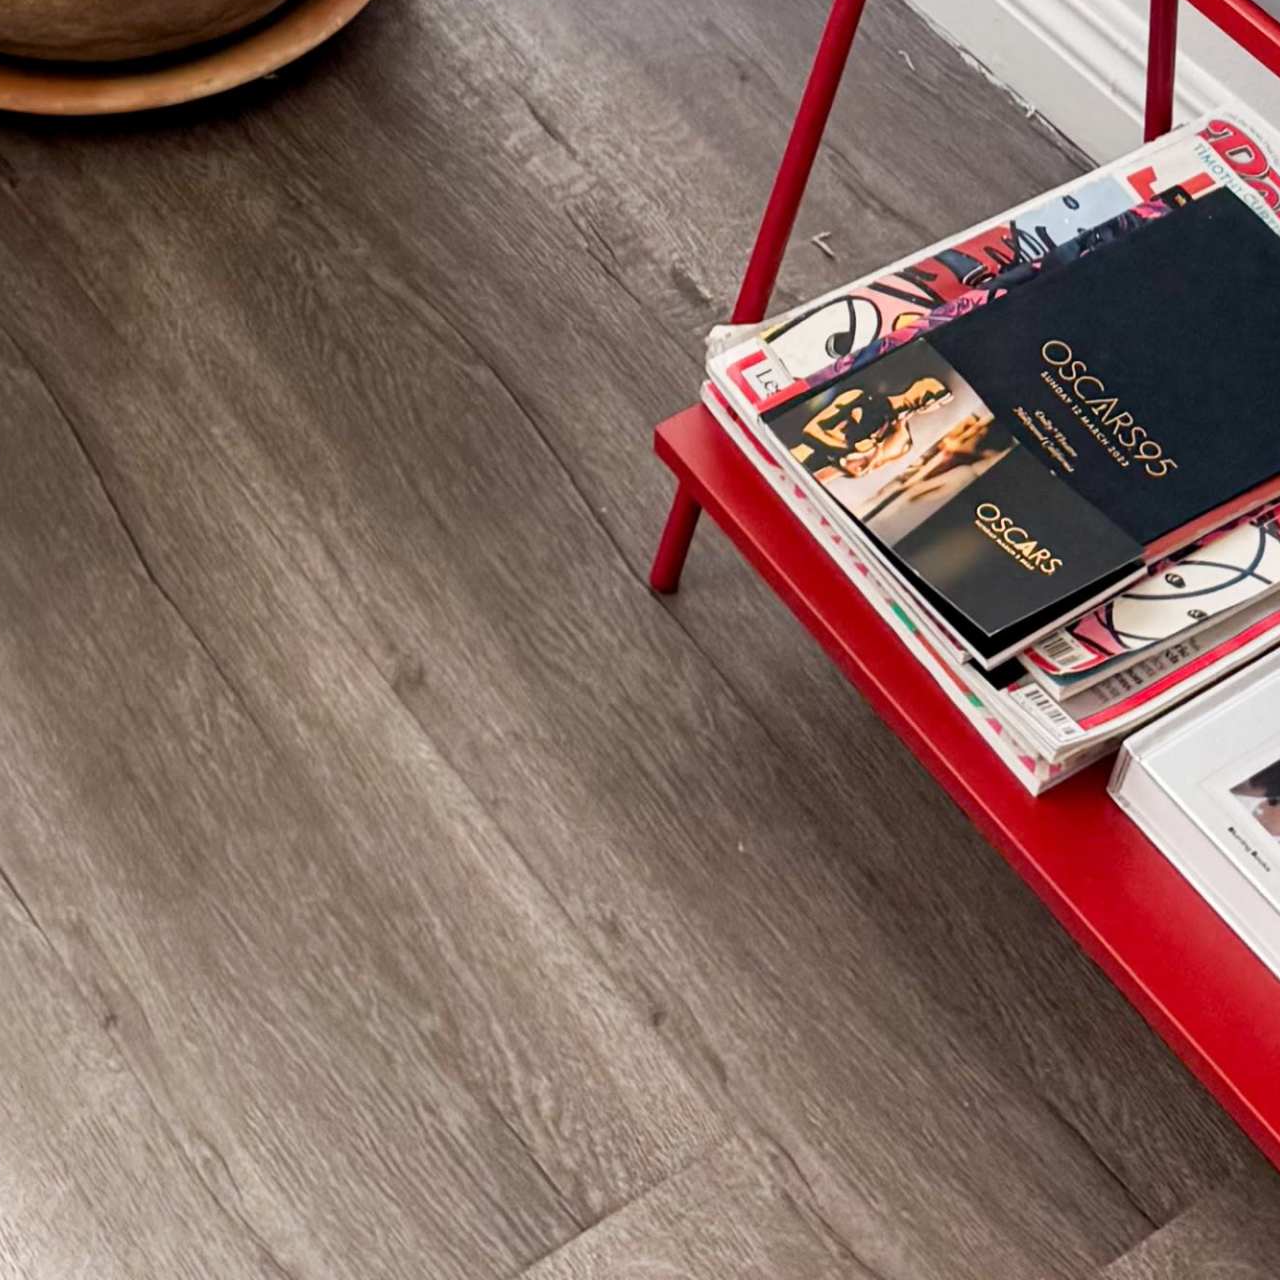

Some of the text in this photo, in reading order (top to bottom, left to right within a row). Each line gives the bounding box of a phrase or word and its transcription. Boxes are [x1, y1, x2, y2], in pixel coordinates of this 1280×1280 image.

[1039, 370, 1130, 468] SUNDAY 12 MARCH 2023
[1041, 339, 1179, 477] OSCARS95
[976, 502, 1063, 575] OSCARS
